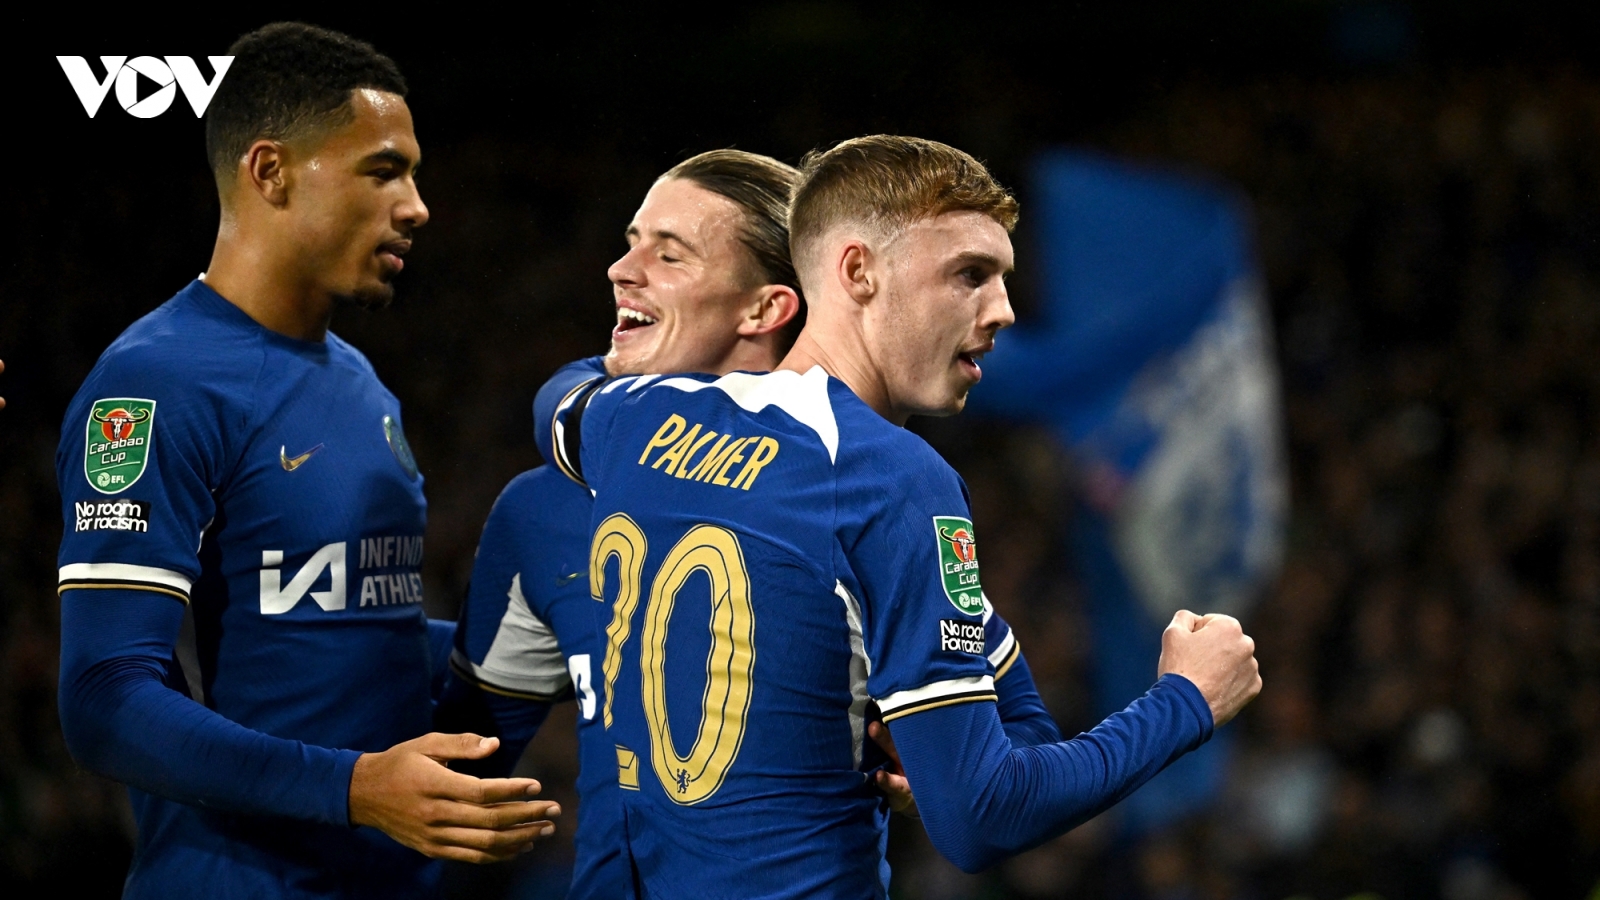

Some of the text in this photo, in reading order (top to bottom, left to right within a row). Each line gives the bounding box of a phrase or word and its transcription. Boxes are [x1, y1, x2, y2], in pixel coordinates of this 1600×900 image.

[89, 437, 145, 455] Carabao
[638, 413, 780, 491] PALMER
[101, 451, 127, 465] Cup
[110, 474, 126, 484] EFL
[75, 501, 142, 518] No room
[93, 516, 148, 533] racism
[945, 559, 979, 574] Caraba
[959, 572, 978, 585] Cup
[359, 572, 423, 608] ATHLE
[970, 596, 983, 607] EFL
[940, 619, 960, 636] No
[589, 512, 756, 806] 20
